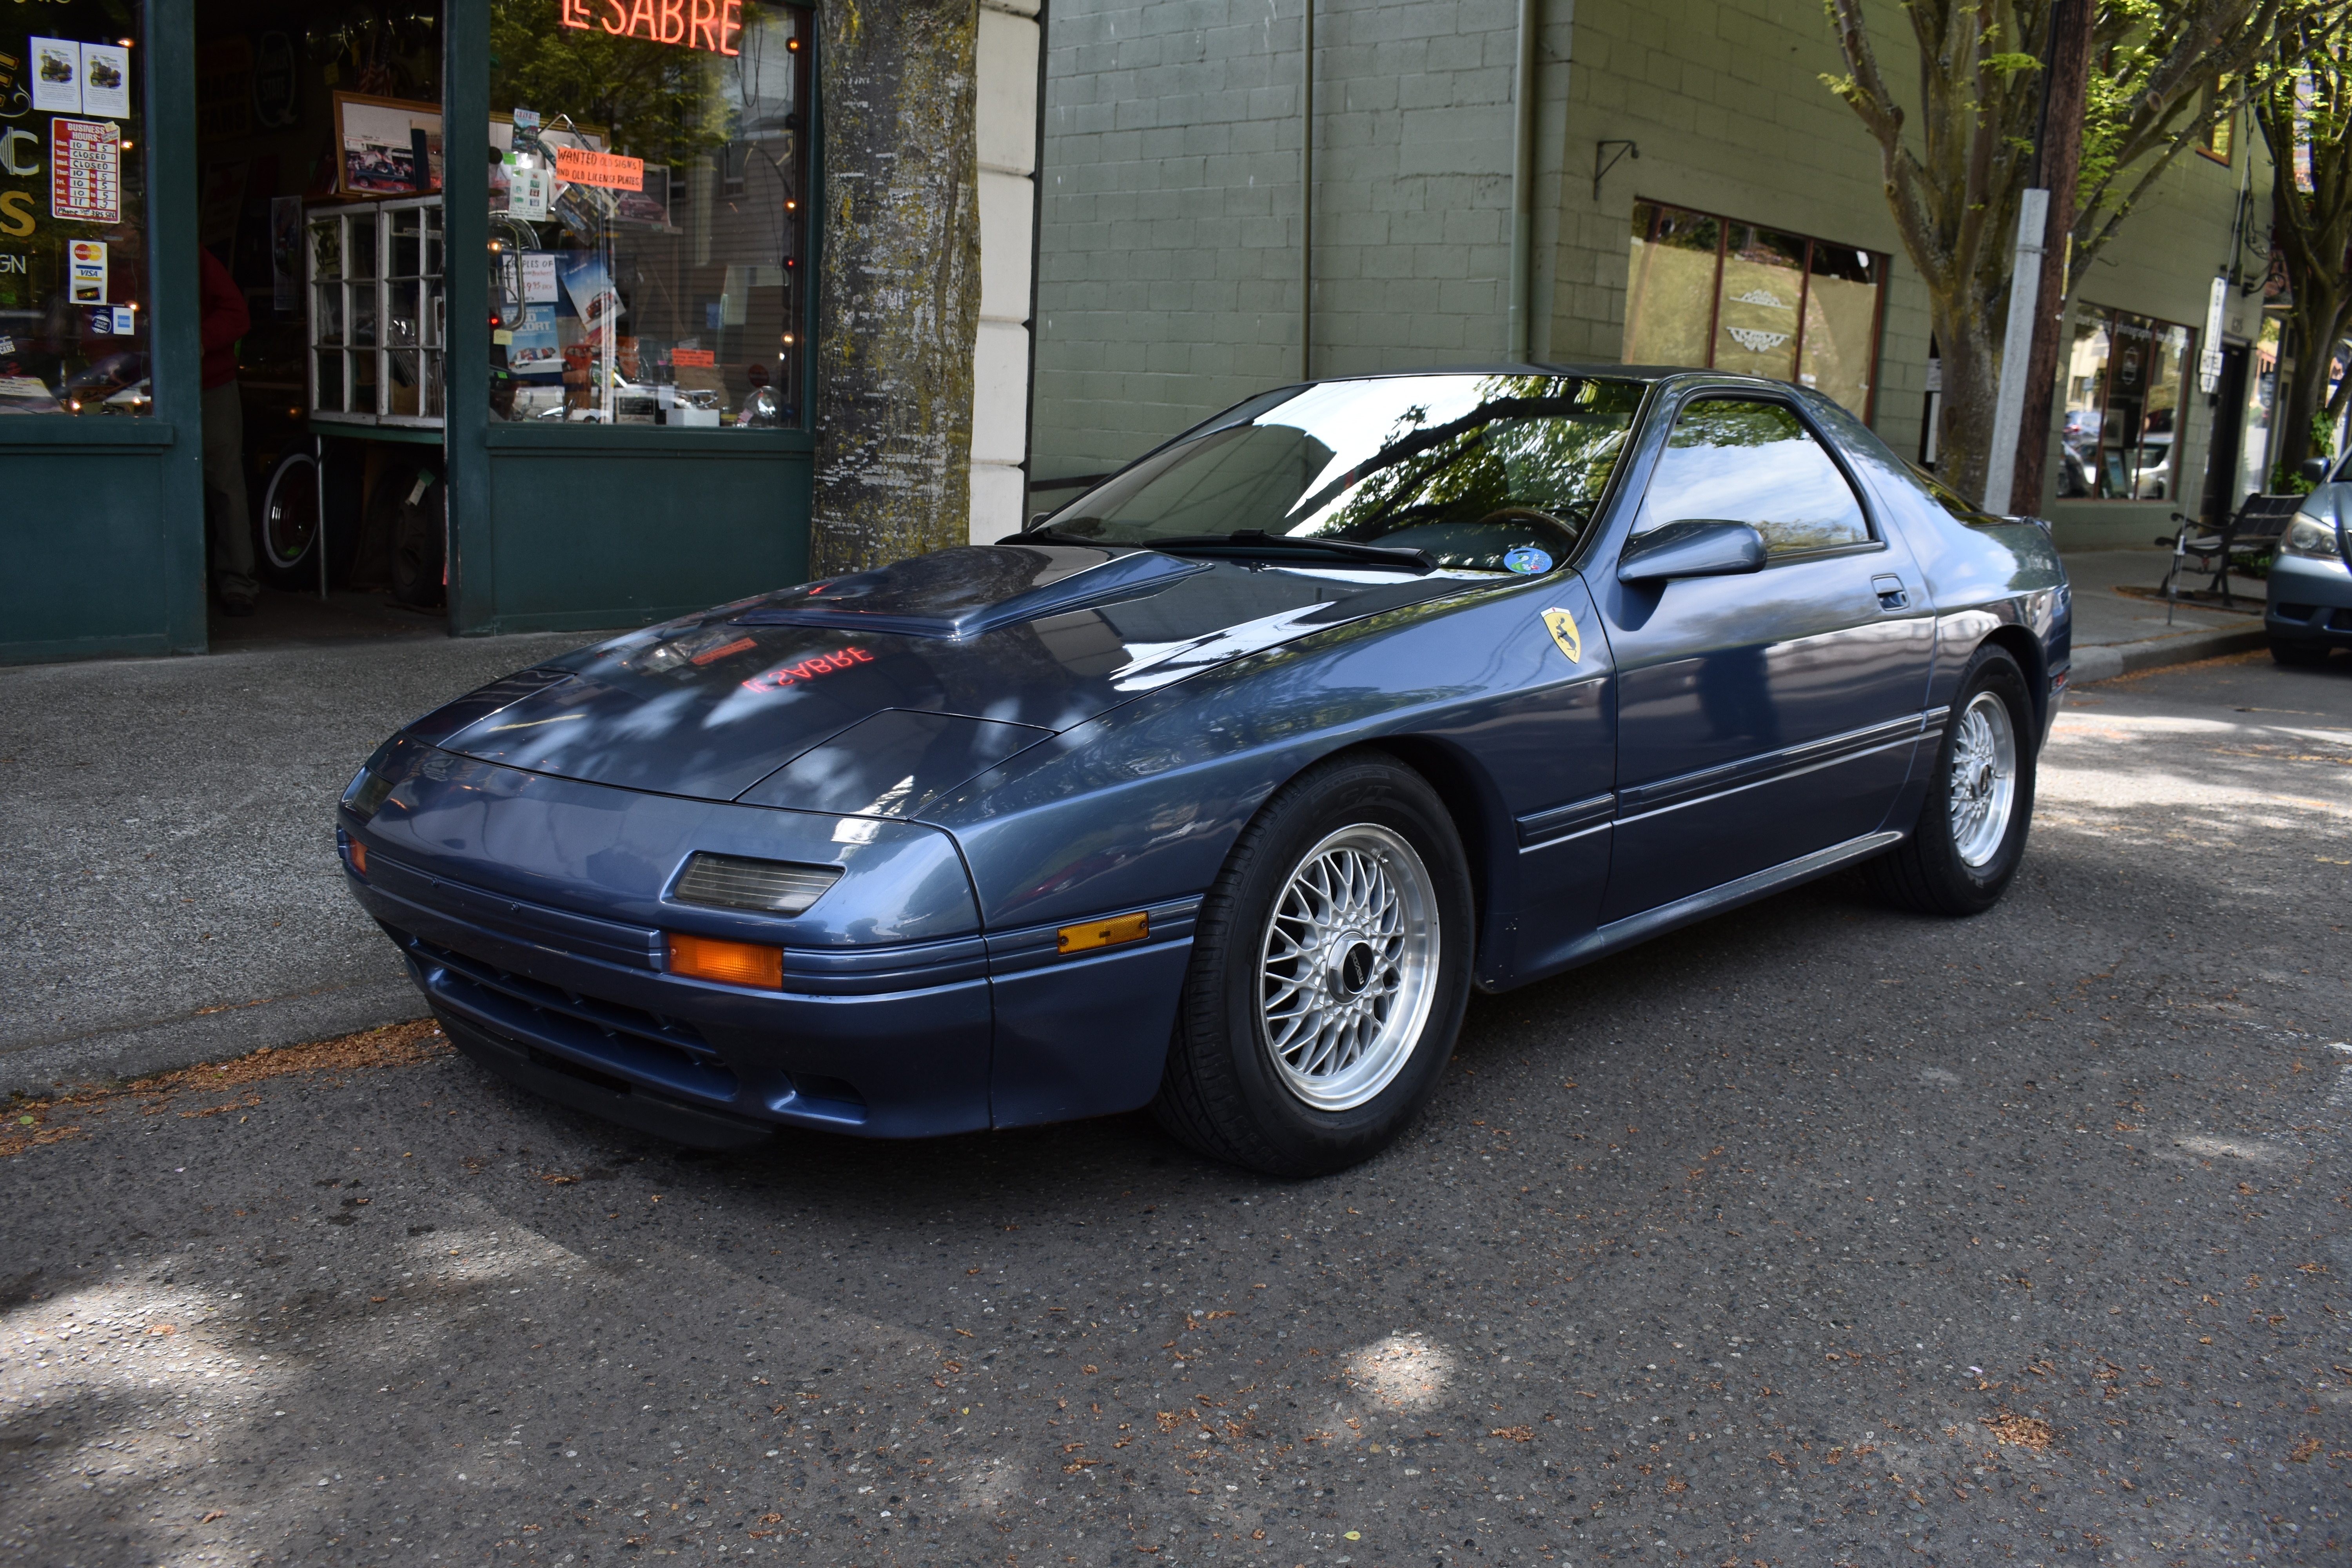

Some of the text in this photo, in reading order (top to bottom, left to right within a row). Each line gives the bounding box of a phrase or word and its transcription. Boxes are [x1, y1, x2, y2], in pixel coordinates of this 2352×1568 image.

[602, 0, 742, 55] SABRE
[67, 123, 105, 134] BUSINESS
[72, 132, 100, 142] HOURS:
[73, 151, 106, 160] CLOSED
[558, 149, 597, 165] WANTED
[600, 157, 612, 167] OLD
[73, 160, 108, 169] CLOSED
[557, 168, 569, 177] AND
[572, 170, 584, 180] OLD
[588, 171, 615, 183] LICENSE
[1337, 785, 1392, 811] G/T
[1350, 949, 1365, 985] mazda
